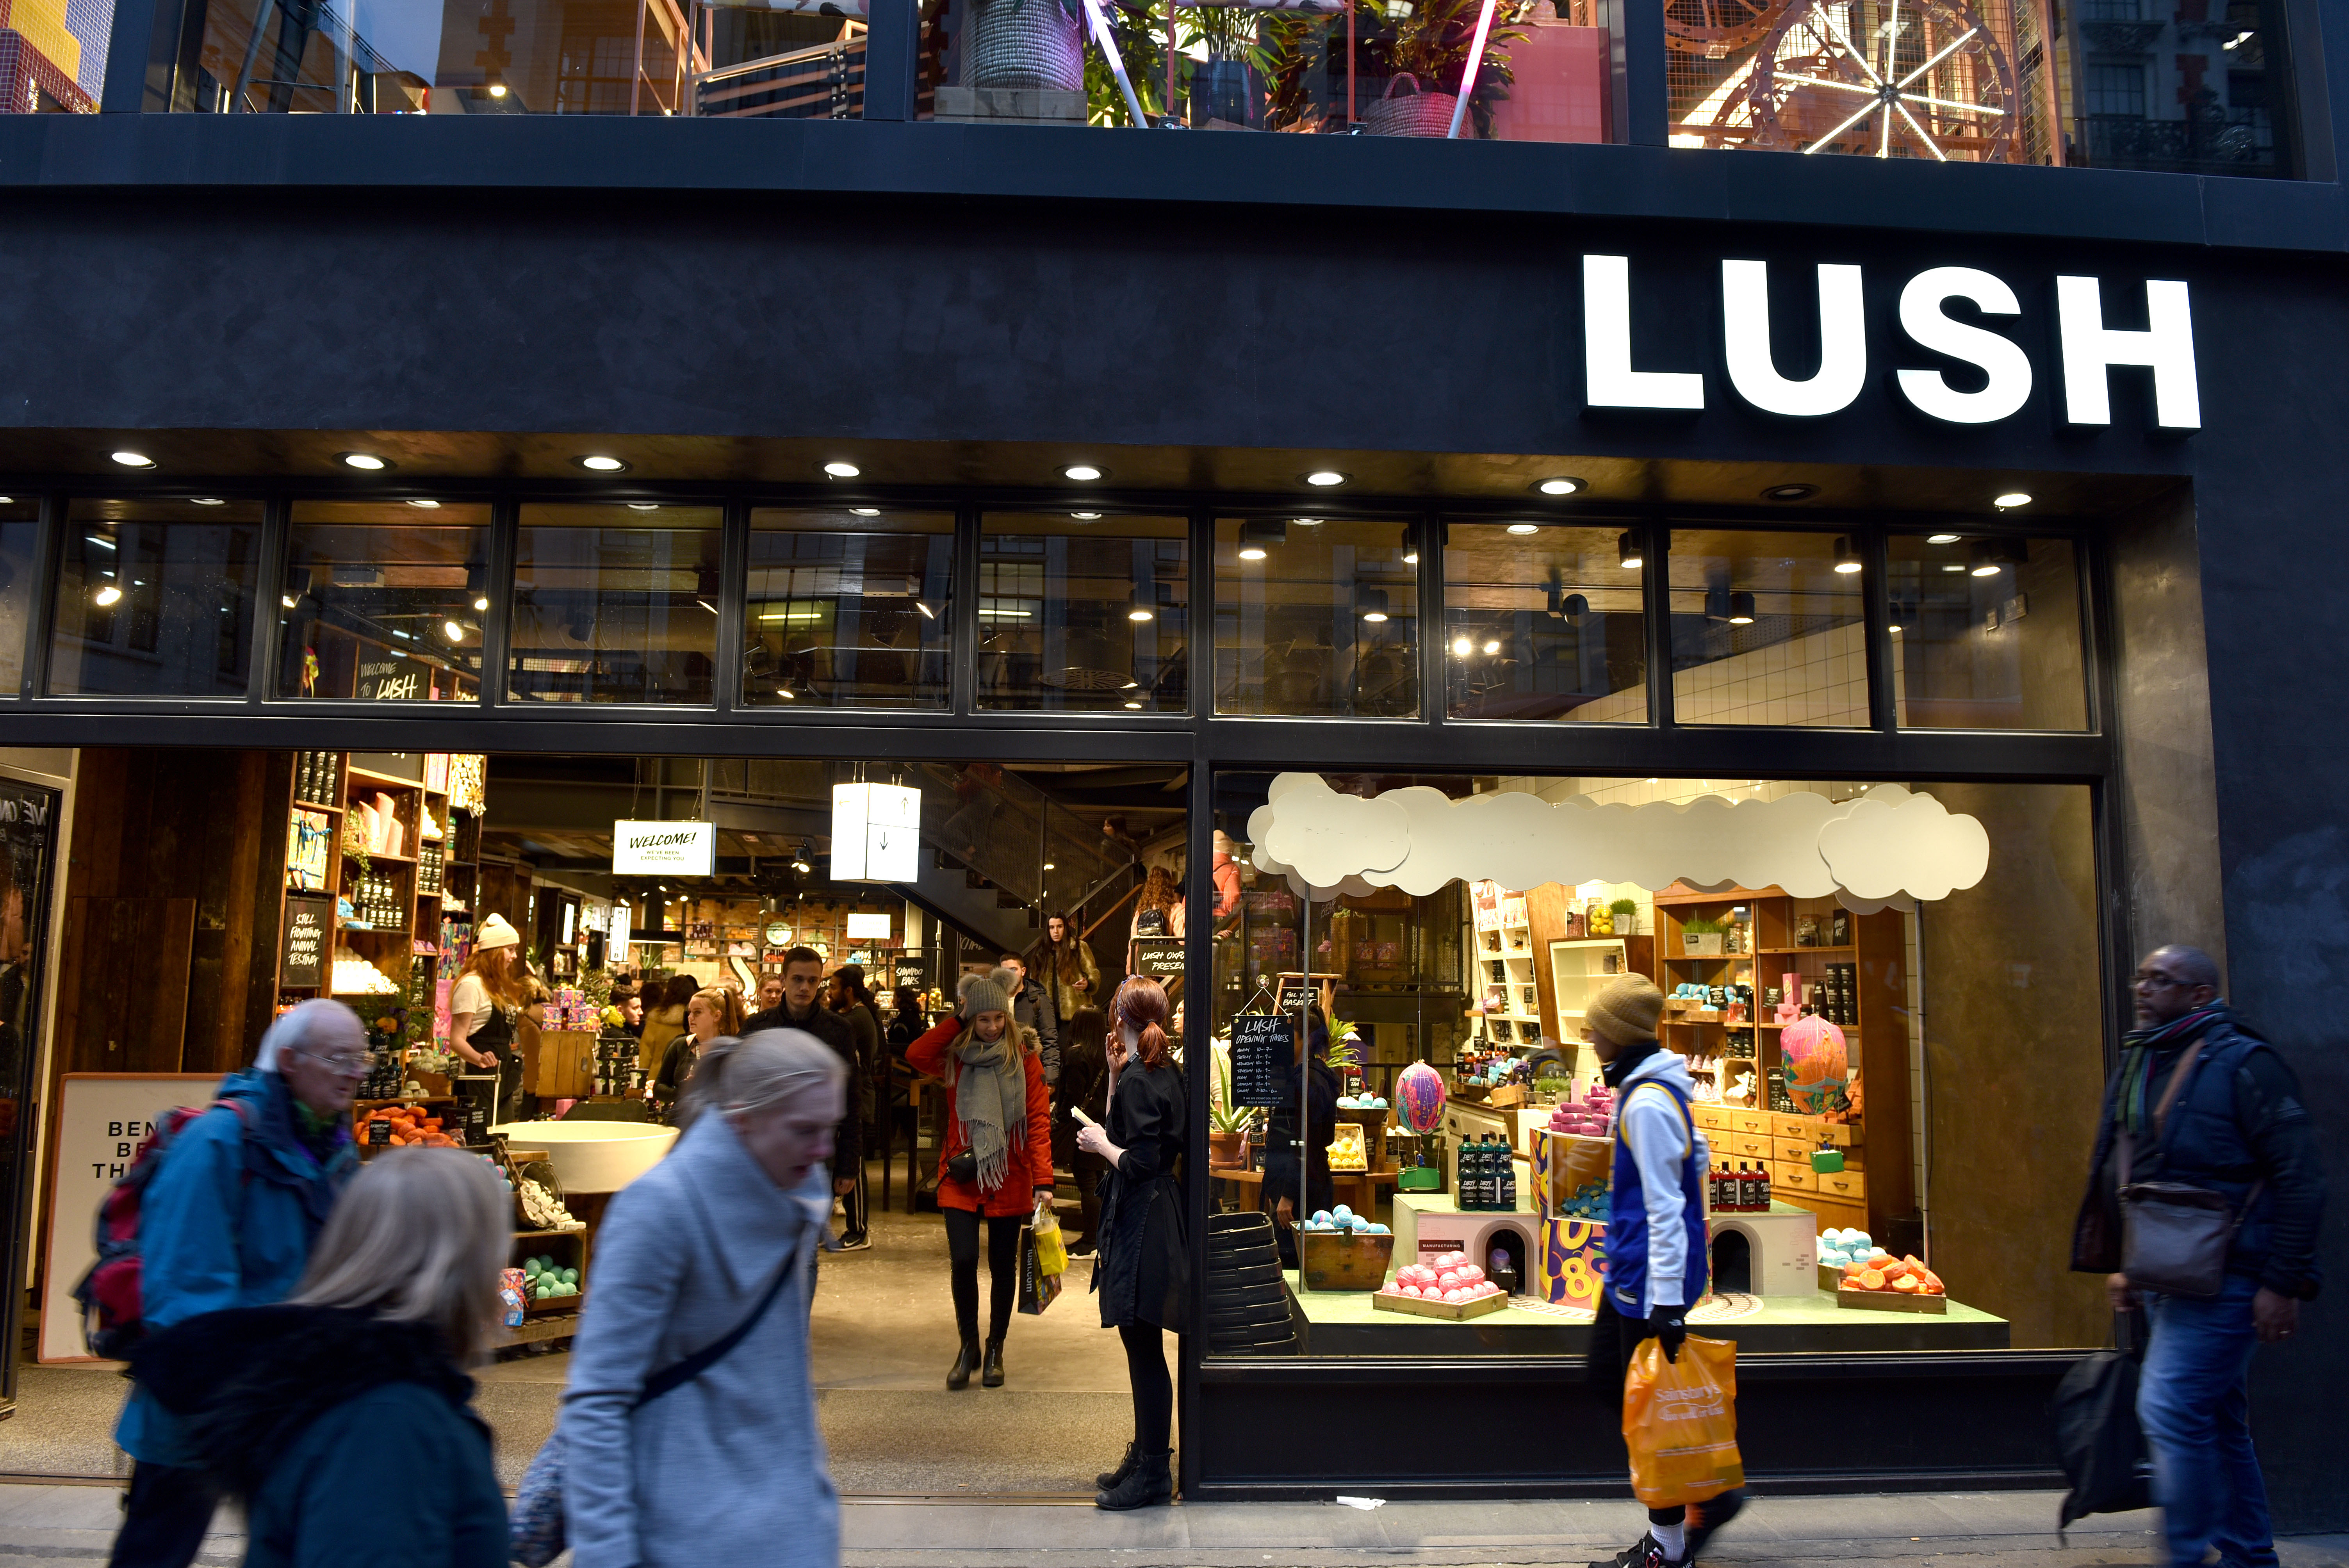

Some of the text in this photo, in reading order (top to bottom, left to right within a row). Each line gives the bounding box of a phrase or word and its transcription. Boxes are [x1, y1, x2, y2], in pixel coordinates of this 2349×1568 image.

[1583, 254, 2201, 429] LUSH
[361, 662, 397, 678] WELCOME
[361, 674, 418, 700] TO LUSH
[630, 832, 697, 848] WELCOME!
[296, 913, 317, 925] STILL
[290, 926, 323, 940] FIGHTING
[290, 940, 318, 952] ANIMAL
[288, 952, 319, 968] TESTING
[1142, 951, 1185, 960] LUSH OXFO
[896, 967, 923, 976] SHAMPOO
[1151, 962, 1185, 971] PRESEN
[901, 976, 919, 986] BARS
[1245, 1017, 1281, 1034] LUSH
[1236, 1033, 1289, 1044] OPENING TIMES
[108, 1122, 159, 1137] BEN
[116, 1142, 148, 1157] BE
